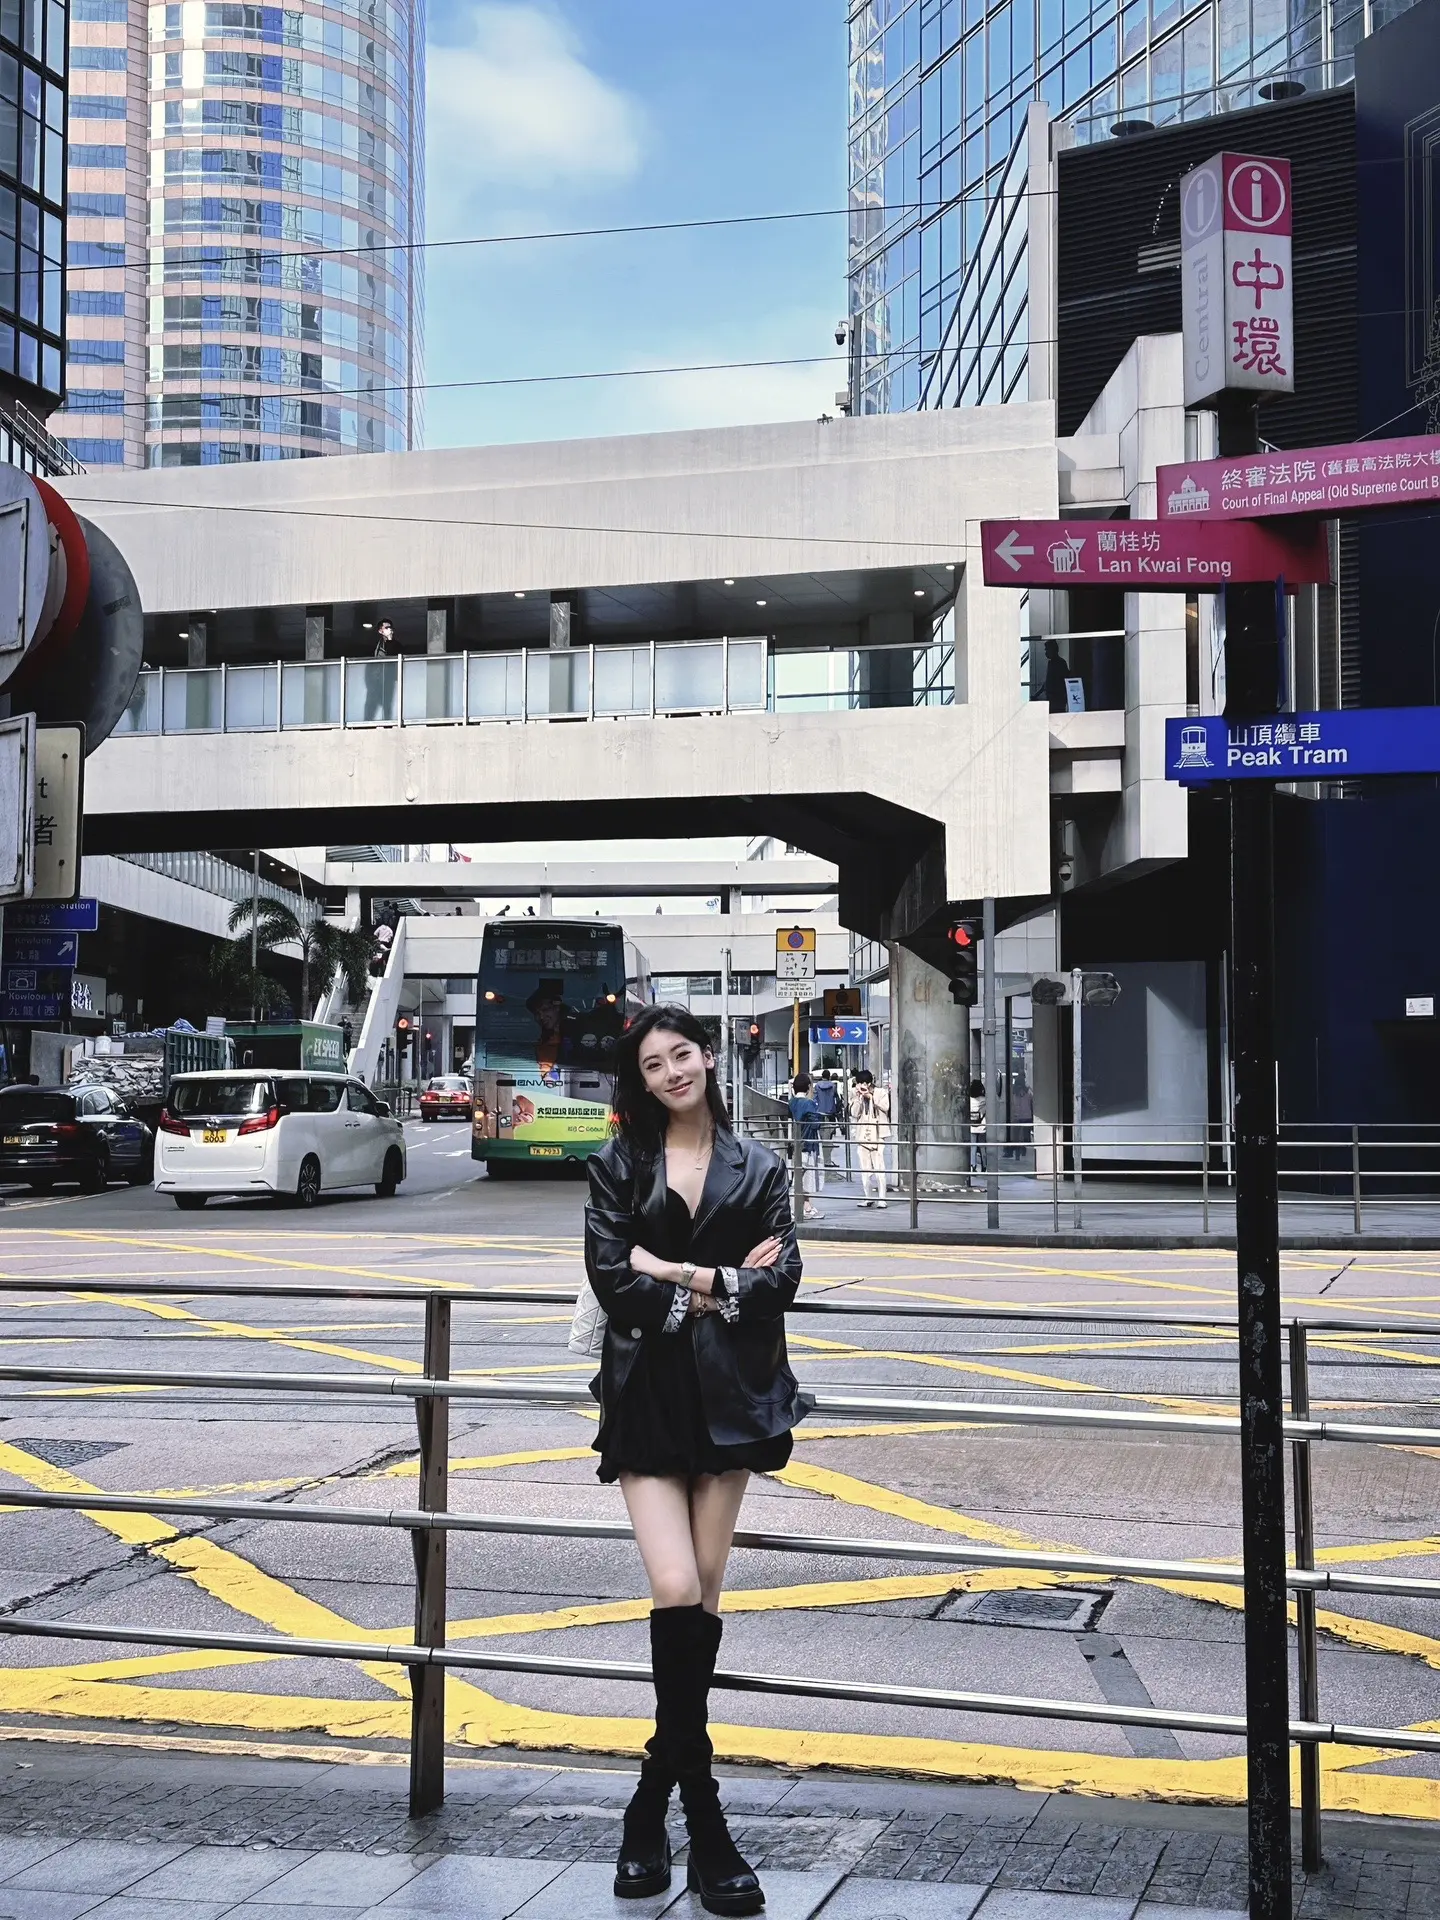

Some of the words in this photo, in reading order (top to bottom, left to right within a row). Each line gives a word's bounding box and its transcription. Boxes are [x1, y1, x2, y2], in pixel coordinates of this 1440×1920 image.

[1192, 253, 1210, 381] Central
[1232, 248, 1287, 376] 中環
[1221, 460, 1317, 490] 終審法院
[1222, 496, 1249, 510] Court
[1251, 493, 1262, 507] of
[1264, 491, 1288, 506] Final
[1291, 486, 1326, 505] Appeal
[1328, 484, 1349, 501] (Old
[1351, 480, 1398, 498] Supreme
[1400, 477, 1429, 491] Court
[1097, 531, 1161, 552] 蘭桂坊
[1098, 557, 1132, 573] Lan
[1138, 557, 1181, 573] Kwai
[1187, 557, 1232, 577] Fong
[1227, 722, 1322, 747] 山頂纜車
[1227, 747, 1282, 767] Peak
[1288, 746, 1349, 765] Tram
[801, 953, 808, 962] 7
[801, 967, 808, 976] 7
